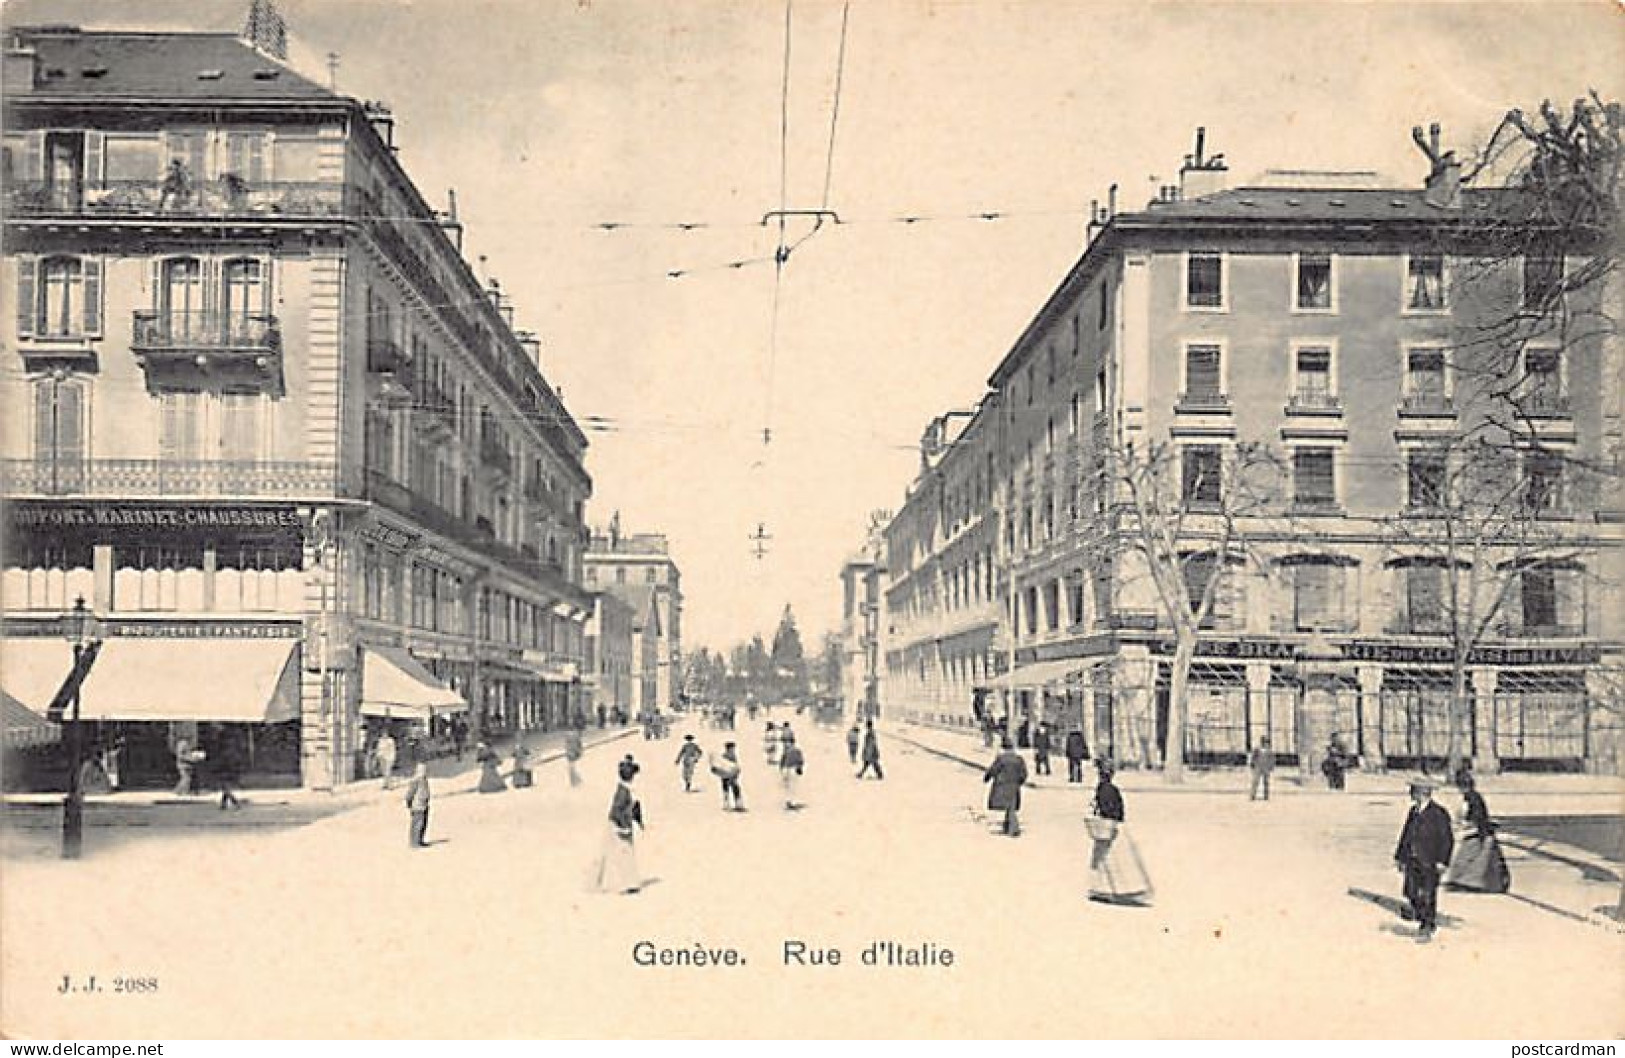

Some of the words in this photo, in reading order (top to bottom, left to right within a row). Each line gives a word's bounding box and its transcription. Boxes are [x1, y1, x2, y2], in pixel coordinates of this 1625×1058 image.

[632, 940, 747, 966] Genève.
[783, 940, 842, 966] Rue
[861, 941, 955, 967] d'Italie
[113, 977, 158, 993] 2088
